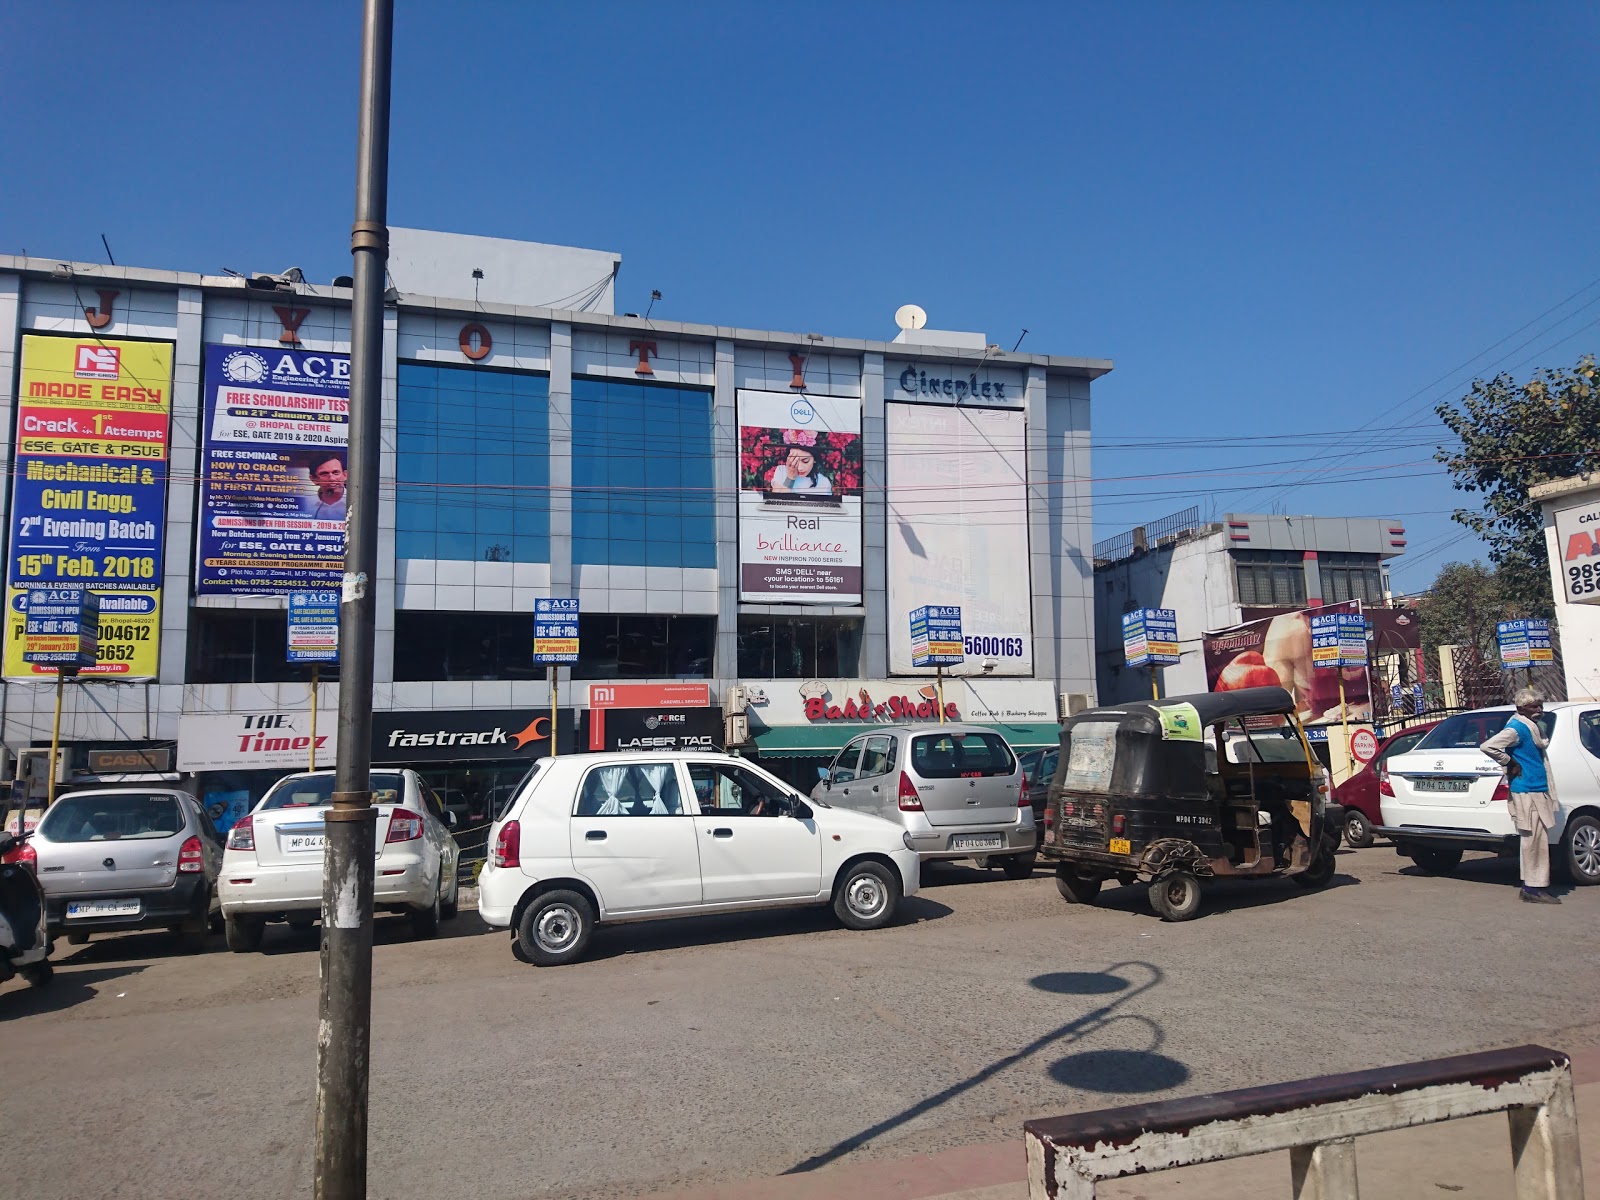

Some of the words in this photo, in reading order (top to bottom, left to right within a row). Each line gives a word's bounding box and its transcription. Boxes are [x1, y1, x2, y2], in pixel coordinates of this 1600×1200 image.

[272, 354, 350, 379] ACE
[272, 375, 318, 386] Engineering
[900, 364, 1006, 399] Cineplex
[30, 381, 92, 400] MADE
[102, 386, 162, 404] EASY
[226, 391, 250, 406] FREE
[253, 394, 325, 411] SCHOLARSHIP
[317, 414, 342, 422] 2018
[793, 408, 812, 416] DELL
[24, 416, 77, 434] Crack
[92, 413, 113, 435] 1st
[104, 426, 163, 440] Attempt
[260, 421, 294, 430] BHOPAL
[297, 423, 331, 433] CENTRE
[233, 430, 250, 439] ESE,
[252, 431, 272, 440] GATE
[274, 432, 293, 441] 2019
[303, 433, 322, 442] 2020
[62, 443, 99, 454] GATE
[106, 444, 115, 455] &
[121, 445, 160, 457] PSUs
[212, 450, 233, 459] FREE
[235, 451, 278, 461] SEMINAR
[27, 461, 136, 484] Mechanical
[141, 467, 155, 485] &
[211, 461, 237, 471] HOW
[238, 463, 250, 471] TO
[252, 463, 287, 473] CRACK
[235, 473, 261, 482] GATE
[211, 482, 222, 491] IN
[224, 483, 252, 492] FIRST
[255, 484, 296, 494] ATTEMPT
[42, 489, 83, 510] Civil
[87, 491, 136, 513] Engg.
[20, 516, 41, 537] 2nd
[44, 518, 102, 541] Evening
[109, 520, 155, 540] Batch
[218, 518, 256, 527] ADMISSIONS
[258, 519, 273, 528] OPEN
[275, 519, 286, 528] FOR
[287, 520, 312, 530] SESSION
[317, 522, 332, 531] 2019
[787, 515, 820, 531] Real
[212, 530, 227, 539] New
[229, 531, 255, 539] Batches
[257, 532, 282, 542] starting
[284, 533, 300, 541] from
[315, 534, 341, 544] January
[73, 542, 101, 553] From
[219, 541, 236, 551] for
[239, 542, 266, 552] ESE,
[270, 543, 301, 552] GATE
[305, 543, 314, 552] &
[757, 533, 848, 554] brilliance.
[260, 553, 287, 561] Evening
[289, 553, 315, 561] Batches
[17, 554, 53, 576] 15th
[57, 555, 99, 578] Feb.
[103, 557, 154, 578] 2018
[238, 560, 280, 568] CLASSROOM
[281, 561, 324, 570] PROGRAMME
[793, 569, 815, 577] 'DELL'
[816, 570, 832, 578] near
[55, 582, 84, 590] EVENING
[119, 583, 156, 591] AVAILABLE
[203, 578, 237, 587] Contact
[238, 579, 249, 587] No:
[48, 591, 80, 600] ACE
[308, 594, 337, 602] ACE
[99, 598, 148, 611] Available
[552, 600, 577, 608] ACE
[916, 608, 926, 618] ACE
[1130, 610, 1143, 620] ACE
[1156, 610, 1174, 618] ACE
[1321, 615, 1336, 623] ACE
[1348, 615, 1364, 623] ACE
[28, 621, 39, 632] ESE
[43, 621, 58, 633] GATE
[1508, 621, 1525, 629] ACE
[38, 643, 61, 653] January
[963, 635, 1023, 657] 5600163
[802, 696, 869, 720] Bake
[242, 715, 291, 729] THE
[657, 714, 686, 722] FORCE
[237, 732, 329, 753] Timez
[388, 727, 507, 748] fastrack
[618, 736, 676, 747] LASER
[680, 735, 712, 746] TAG
[1354, 742, 1376, 750] PARKING
[99, 755, 156, 767] CASIO
[1415, 781, 1426, 790] MP
[1427, 781, 1435, 790] 04
[291, 840, 303, 848] MP
[305, 839, 316, 847] 04
[955, 839, 965, 848] MP
[79, 905, 91, 914] MP
